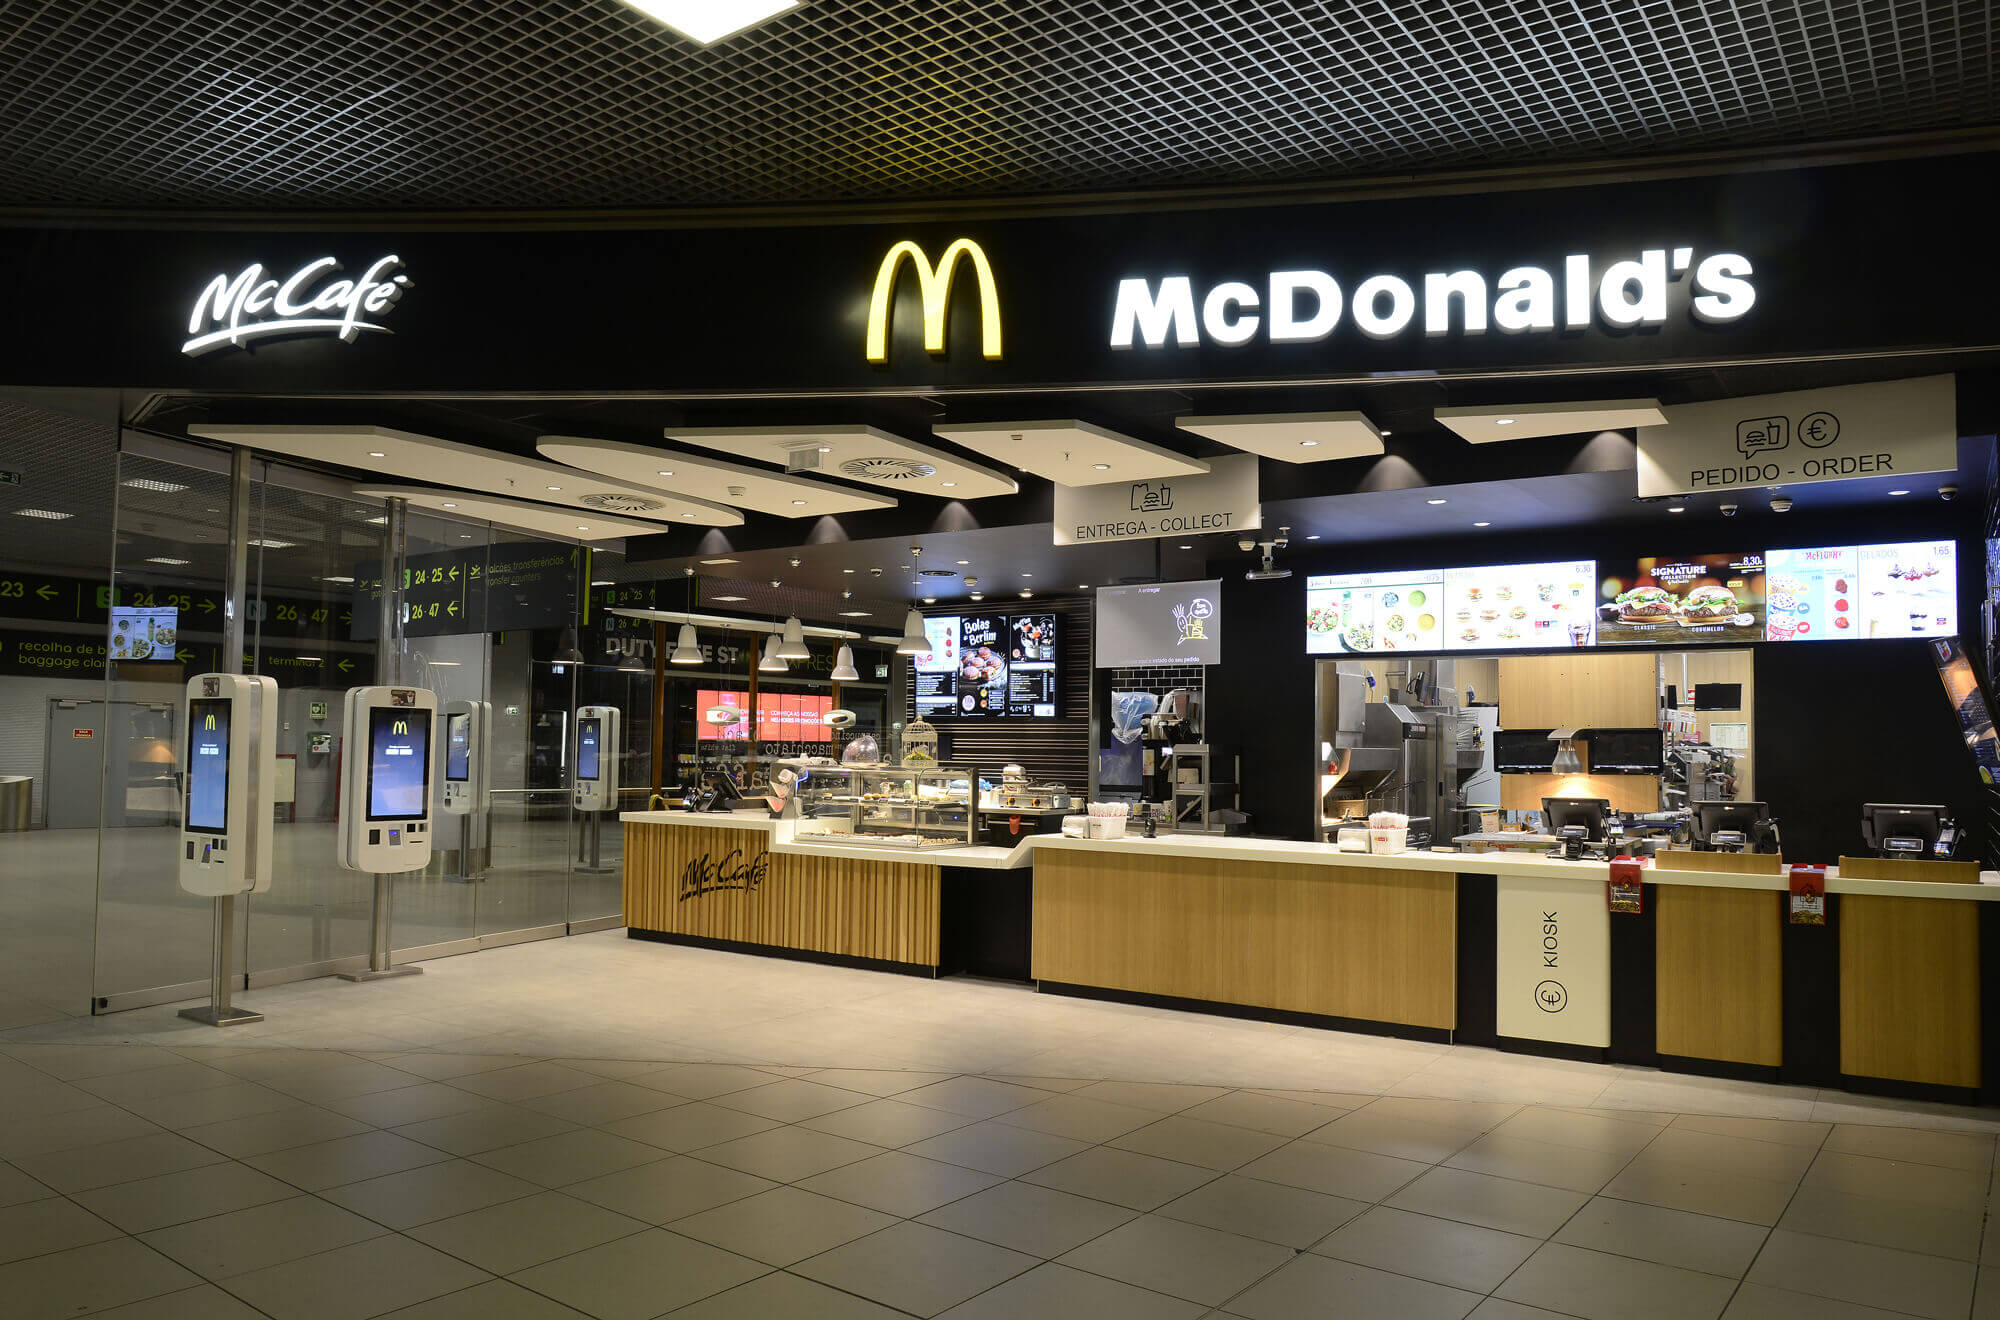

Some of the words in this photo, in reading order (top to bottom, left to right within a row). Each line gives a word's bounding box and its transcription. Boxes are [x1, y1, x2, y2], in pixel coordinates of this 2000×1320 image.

[182, 255, 408, 352] McCafé
[1110, 247, 1757, 350] McDonald's
[1691, 463, 1780, 487] PEDIDO
[1802, 453, 1894, 478] ORDER
[1076, 522, 1147, 539] ENTREGA
[1160, 512, 1233, 533] COLLECT
[415, 570, 426, 585] 24
[431, 567, 443, 583] 25
[1650, 565, 1707, 577] SIGNATURE
[1660, 574, 1697, 582] COLLECTION
[133, 593, 155, 607] 24
[276, 605, 298, 621] 26
[311, 609, 328, 623] 47
[412, 605, 423, 619] 26
[429, 602, 440, 617] 47
[964, 618, 990, 634] Bolas
[969, 630, 997, 646] Berlim
[19, 641, 72, 654] recolha
[76, 643, 94, 654] de
[606, 637, 656, 658] DUTY
[19, 654, 79, 668] baggage
[1543, 910, 1558, 968] KIOSK
